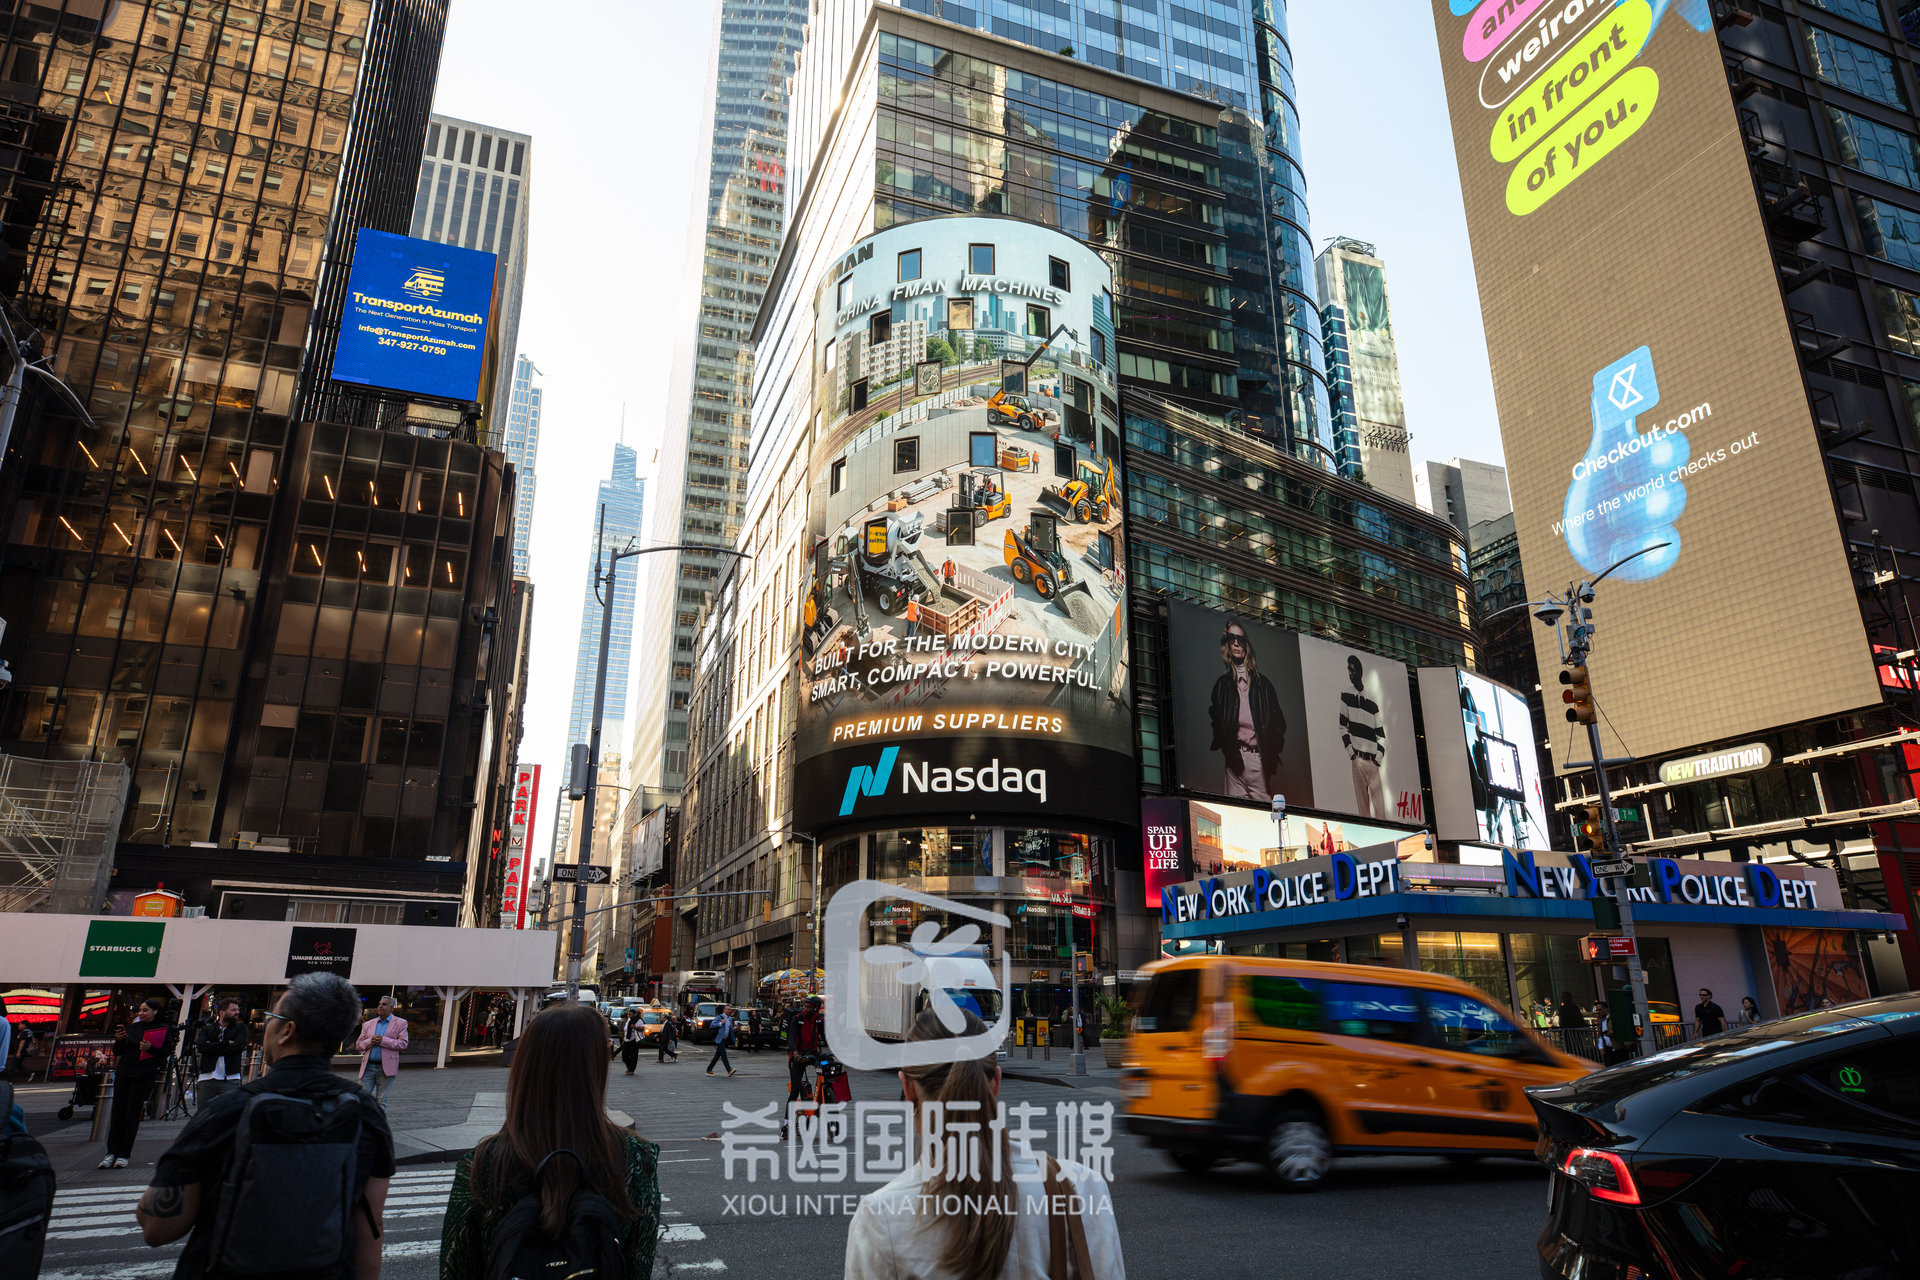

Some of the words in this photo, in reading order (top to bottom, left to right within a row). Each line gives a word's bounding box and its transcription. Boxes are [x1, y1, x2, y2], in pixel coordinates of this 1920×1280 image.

[1498, 0, 1605, 84] weird
[1506, 106, 1537, 142] in
[1542, 23, 1628, 112] front
[1526, 146, 1561, 192] of
[1564, 98, 1638, 169] you.
[353, 292, 483, 325] TransportAzumah
[354, 306, 367, 315] The
[384, 312, 421, 324] Generation
[429, 319, 446, 328] Mass
[446, 323, 477, 333] Transport
[837, 294, 882, 327] CHINA
[892, 279, 949, 301] FMAN
[961, 278, 1065, 306] MACHINES
[378, 337, 447, 356] 347-927-0750
[1571, 402, 1712, 482] Checkout.com
[1551, 506, 1596, 537] Where
[1598, 496, 1622, 516] the
[1623, 477, 1666, 509] world
[1668, 447, 1727, 484] checks
[1729, 430, 1761, 456] out
[815, 646, 853, 675] BUILT
[857, 639, 897, 661] FOR
[903, 634, 947, 652] THE
[952, 634, 1047, 653] MODERN
[1054, 640, 1098, 664] CITY.
[811, 671, 861, 702] SMART,
[867, 661, 979, 686] COMPACT,
[985, 661, 1102, 691] POWERFUL.
[833, 715, 923, 742] PREMIUM
[932, 713, 1064, 733] SUPPLIERS
[513, 772, 531, 825] PARK
[902, 758, 1047, 804] Nasdaq
[1396, 791, 1422, 822] H&M
[1147, 825, 1177, 834] SPAIN
[1148, 834, 1178, 850] UP
[1149, 850, 1178, 859] YOUR
[1149, 858, 1179, 870] LIFE
[1615, 863, 1628, 871] WAY
[504, 857, 521, 913] PARK
[561, 869, 578, 878] ONE
[1161, 885, 1199, 925] NEW
[1199, 878, 1250, 919] YORK
[1253, 868, 1326, 912] POLICE
[1331, 853, 1399, 900] DEPT
[1503, 848, 1576, 899] NEW
[1652, 858, 1750, 907] POLICE
[1748, 865, 1818, 909] DEPT
[1026, 904, 1047, 914] Nasdaq
[89, 945, 143, 953] STARBUCKS
